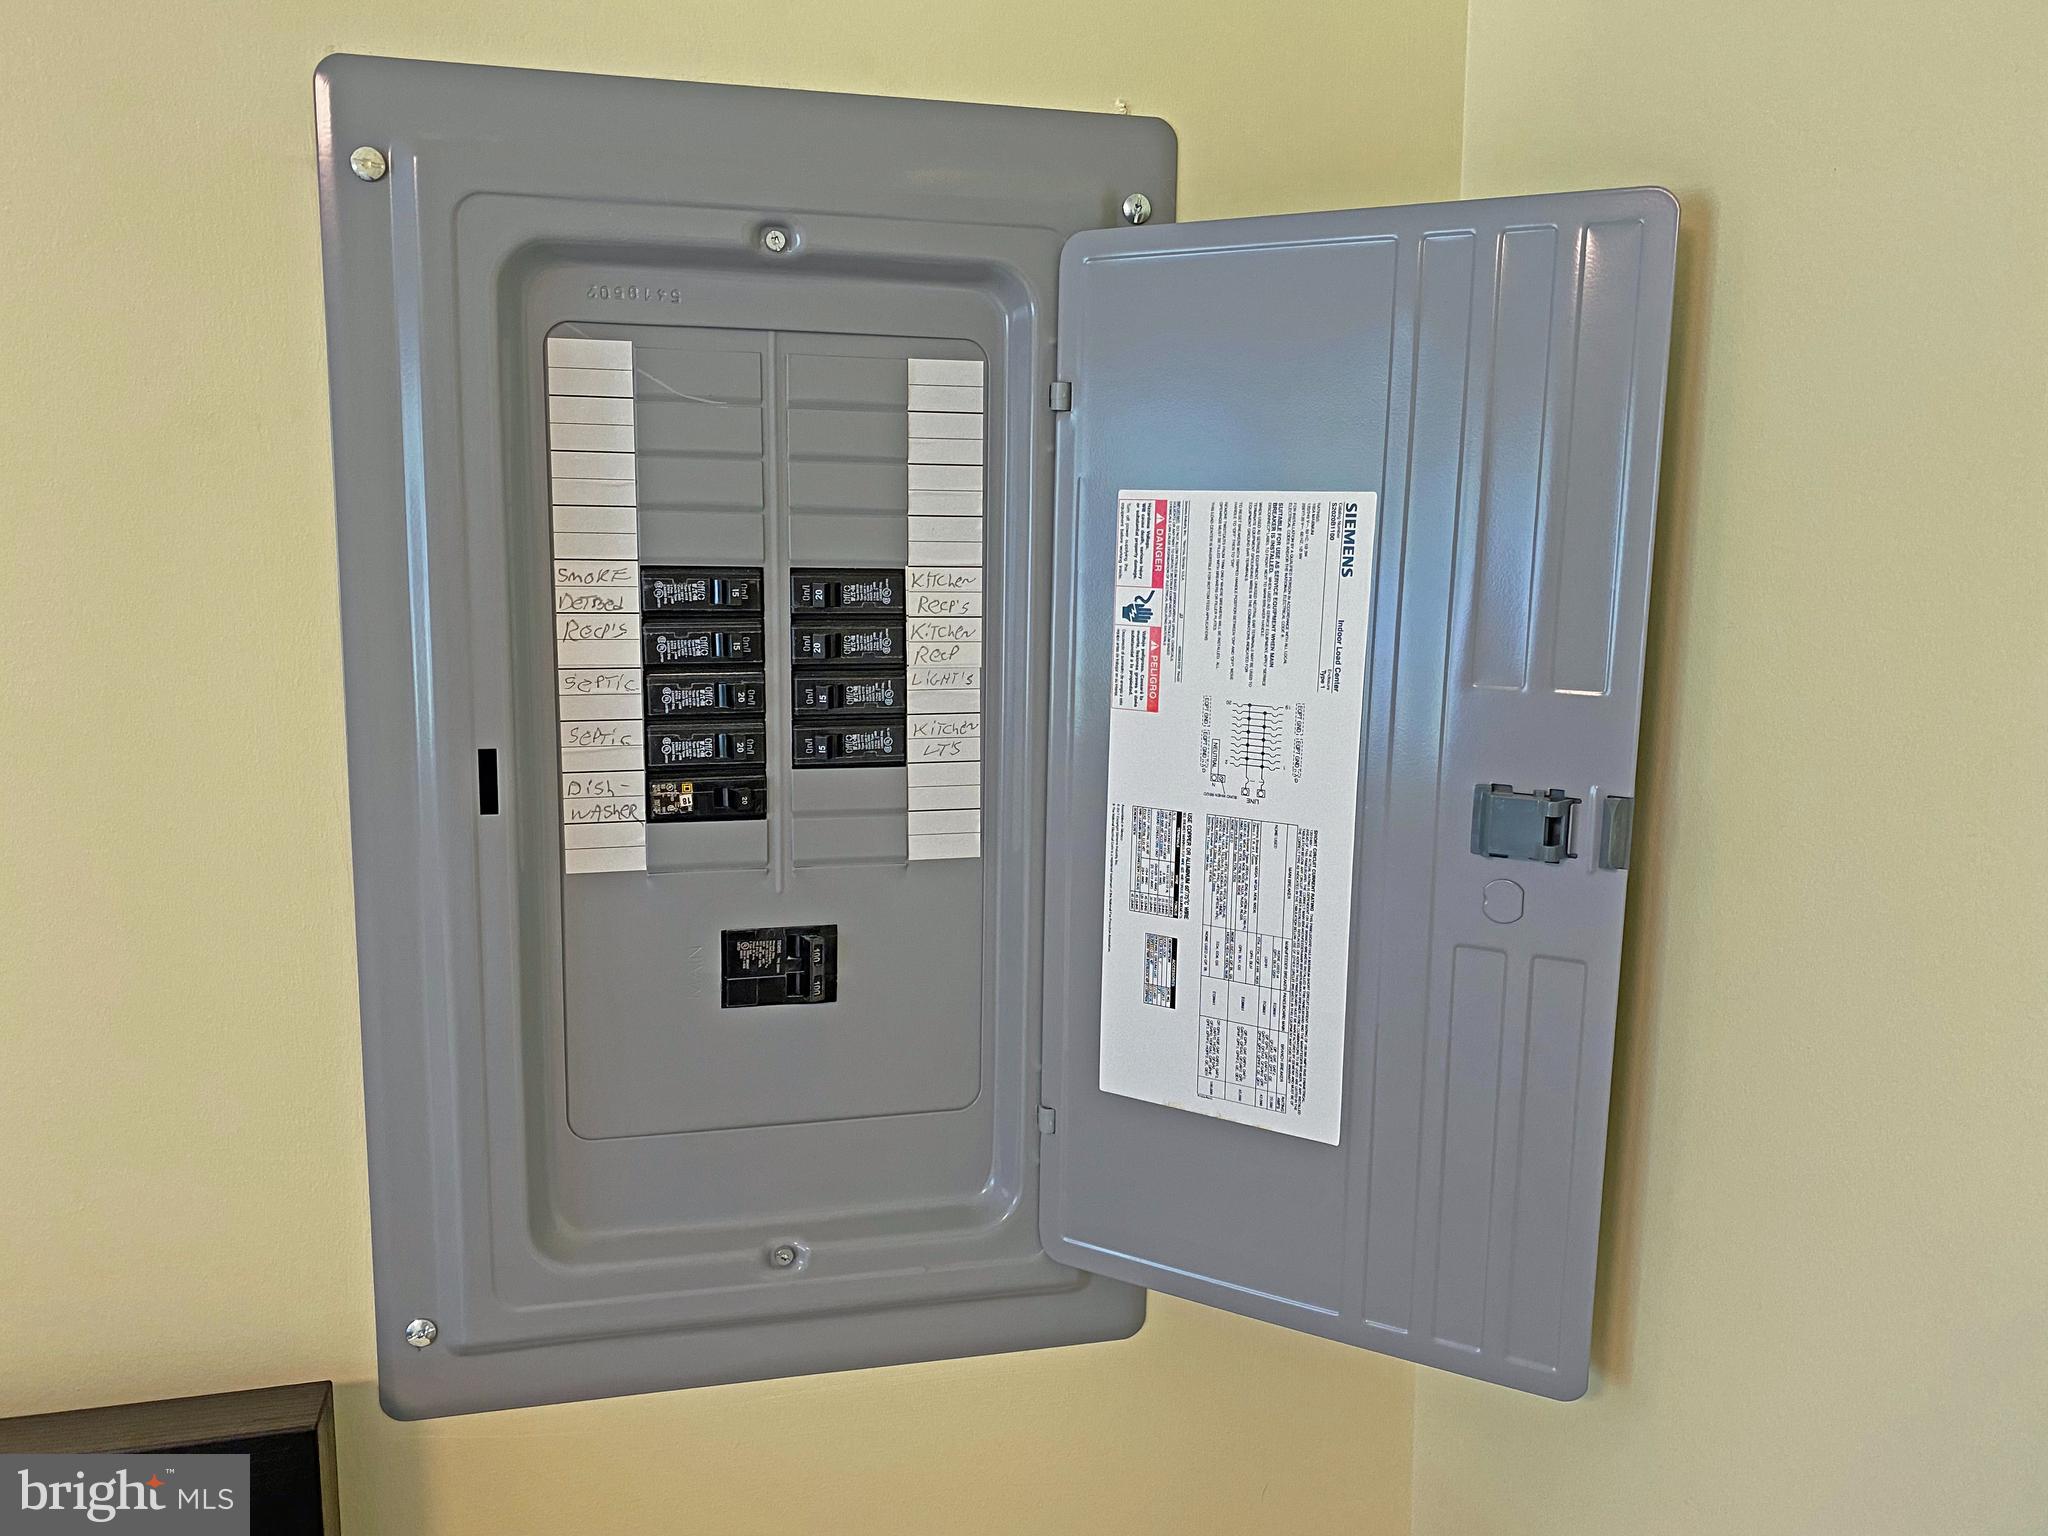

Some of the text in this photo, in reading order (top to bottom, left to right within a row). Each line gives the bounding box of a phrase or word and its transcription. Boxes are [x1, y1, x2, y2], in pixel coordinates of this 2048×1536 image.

[1342, 503, 1358, 578] SIEMENS
[1154, 528, 1163, 572] DANGER
[732, 588, 740, 597] 15
[815, 590, 822, 600] 20
[733, 642, 740, 651] 15
[813, 643, 821, 653] 20
[1149, 655, 1158, 699] PELIGRO
[738, 692, 745, 703] 20
[737, 742, 744, 753] 20
[742, 796, 748, 805] 20
[1186, 848, 1191, 856] OR
